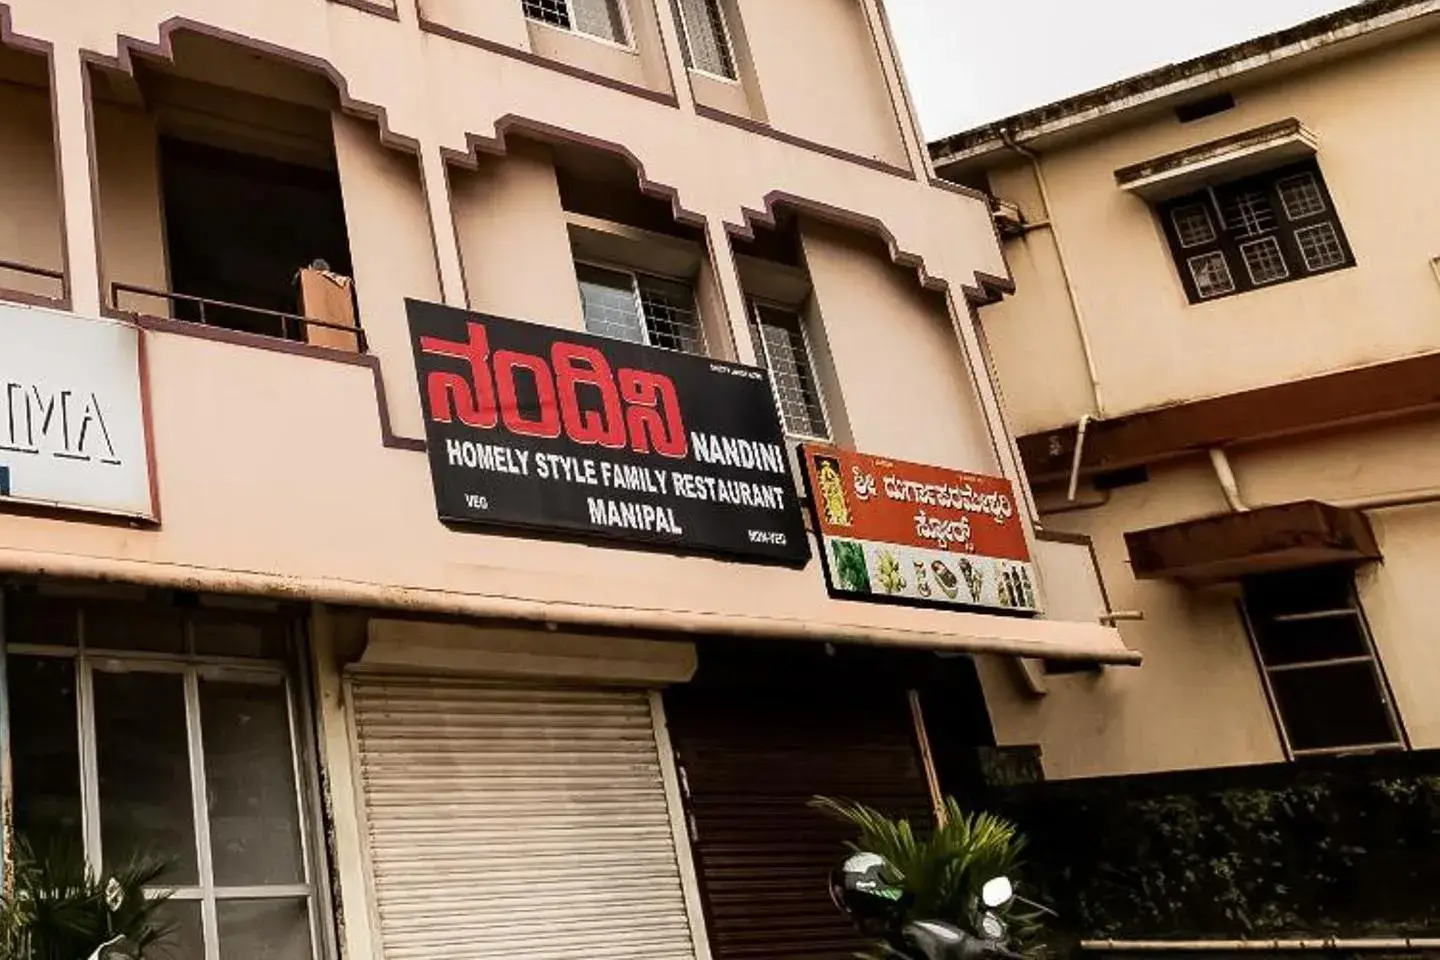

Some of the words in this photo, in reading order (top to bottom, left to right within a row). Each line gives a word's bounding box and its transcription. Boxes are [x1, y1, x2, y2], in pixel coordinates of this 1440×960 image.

[420, 321, 689, 458] ನಂದಿನಿ
[445, 438, 529, 476] HOMELY
[535, 452, 599, 486] STYLE
[600, 461, 667, 495] FAMILY
[671, 471, 786, 510] RESTAURANT
[690, 431, 786, 474] NANDINI
[587, 496, 683, 535] MANIPAL
